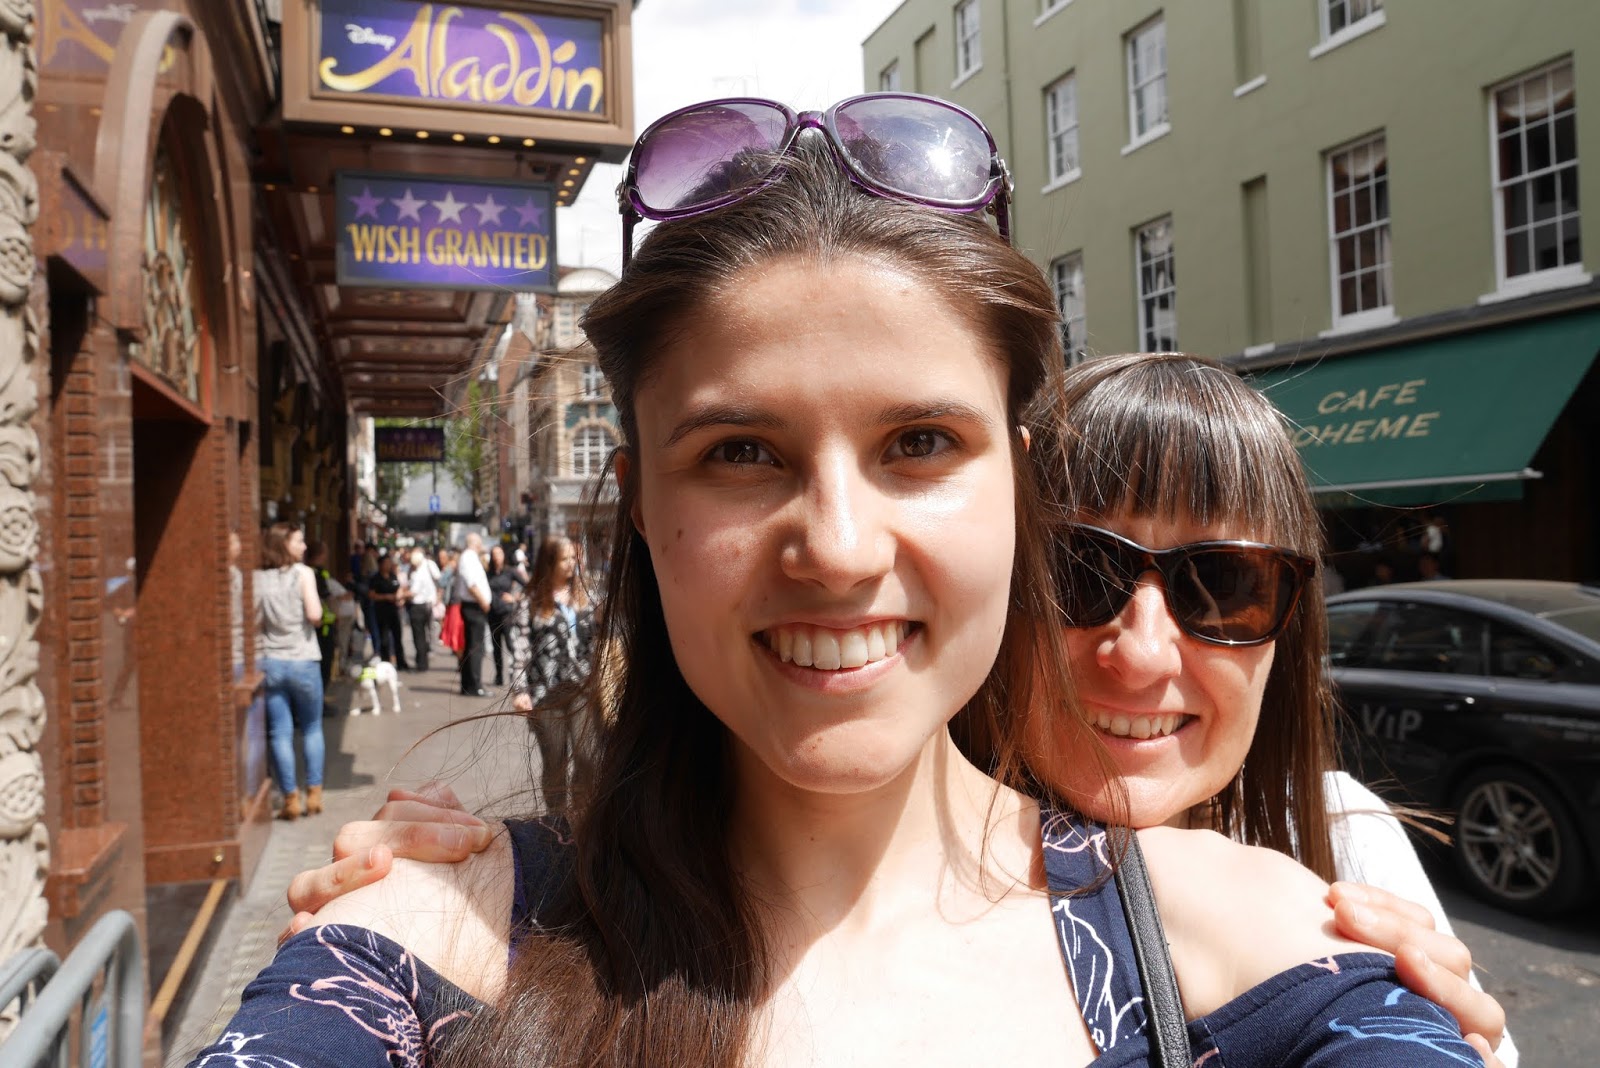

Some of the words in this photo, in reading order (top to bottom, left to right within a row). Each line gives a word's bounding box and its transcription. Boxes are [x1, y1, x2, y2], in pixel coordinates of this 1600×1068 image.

[319, 3, 604, 112] Aladdin
[1317, 378, 1426, 415] CAFE
[1289, 411, 1440, 448] OHEME
